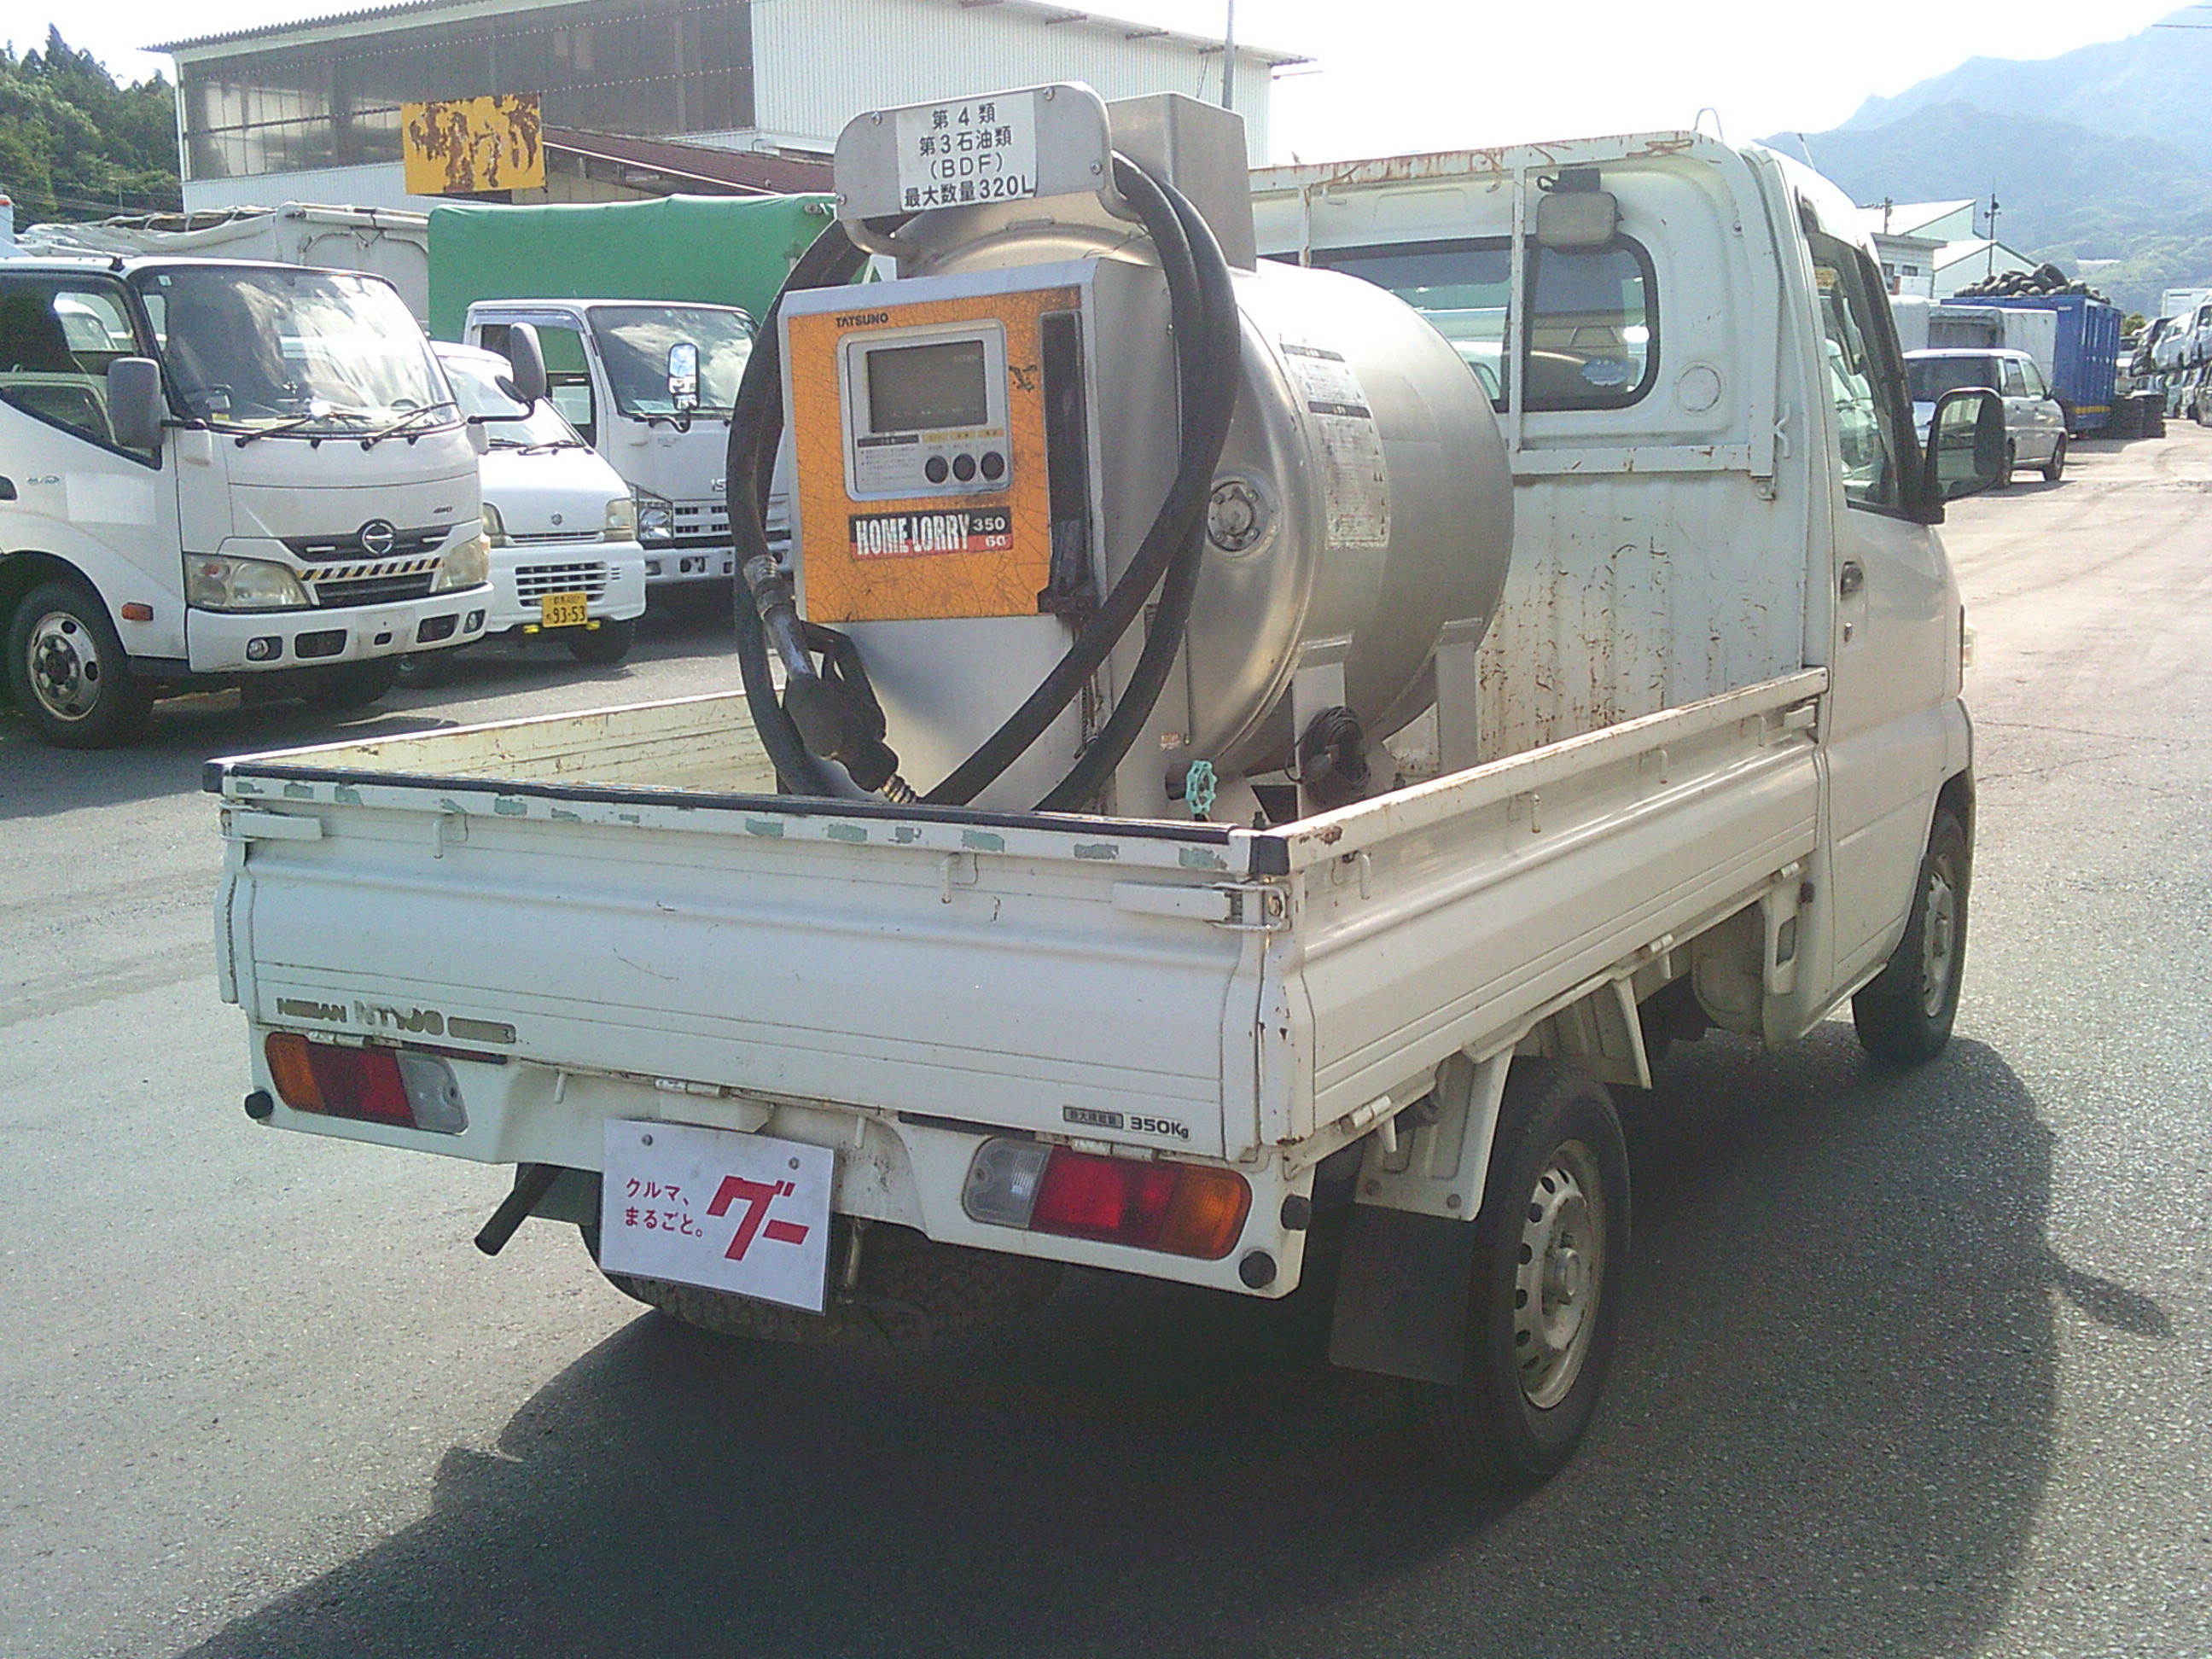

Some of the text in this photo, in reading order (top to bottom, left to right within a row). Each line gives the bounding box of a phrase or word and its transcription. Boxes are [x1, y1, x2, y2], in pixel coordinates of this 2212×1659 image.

[919, 125, 1012, 156] 第3石油類
[930, 153, 1003, 180] (BDF)
[835, 312, 888, 328] TATSUNO
[855, 514, 1005, 555] HOME LORRY 350
[985, 535, 1006, 547] 60
[1131, 1116, 1189, 1139] 350Kg
[626, 1178, 689, 1206] クルマ、
[625, 1206, 703, 1238] まるごと。
[707, 1175, 809, 1261] グー
